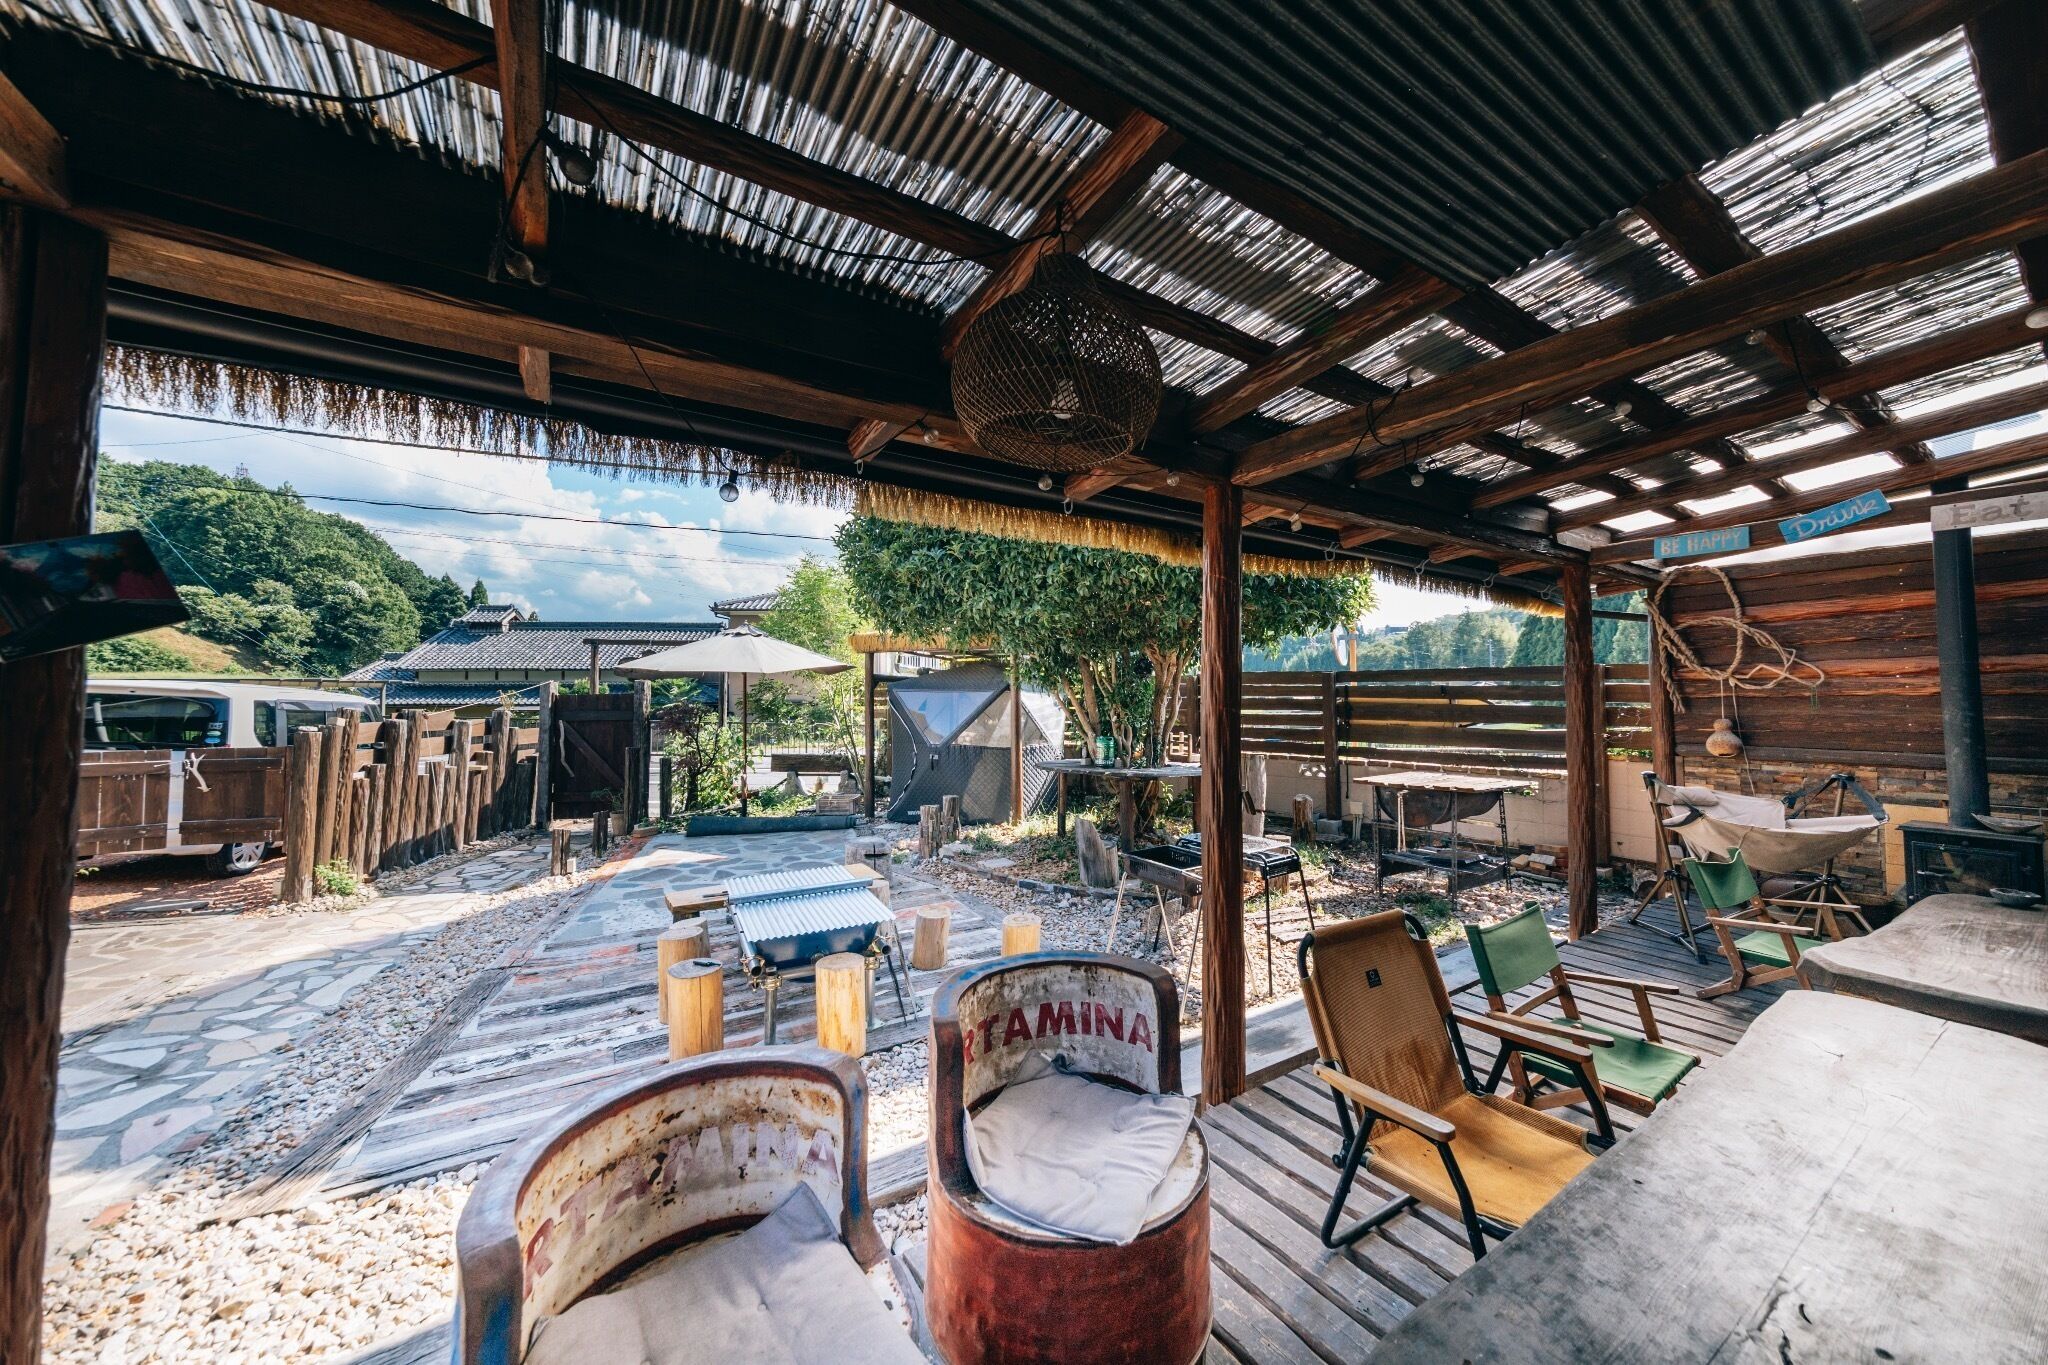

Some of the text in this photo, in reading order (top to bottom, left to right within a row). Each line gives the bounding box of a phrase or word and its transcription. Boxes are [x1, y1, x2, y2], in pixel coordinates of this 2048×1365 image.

[1788, 498, 1881, 539] Drink
[1950, 497, 2034, 526] Eat
[1661, 528, 1743, 555] BE HAPPY
